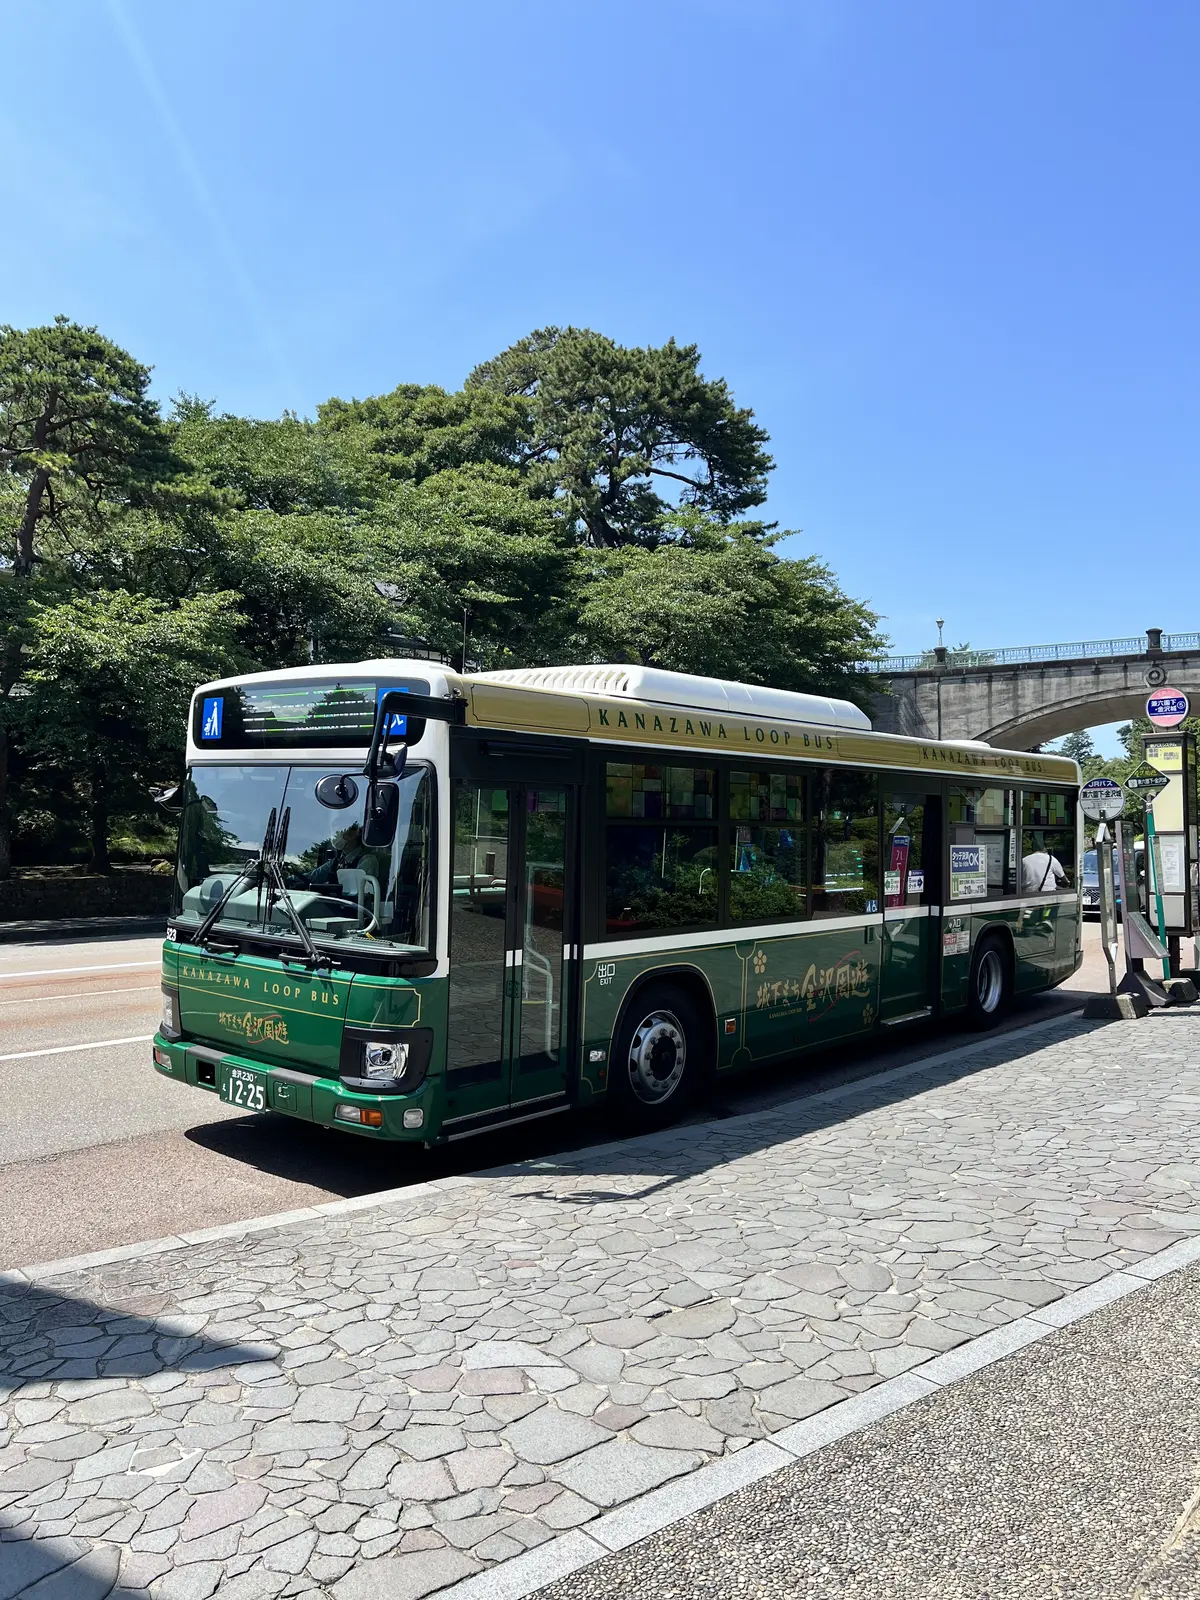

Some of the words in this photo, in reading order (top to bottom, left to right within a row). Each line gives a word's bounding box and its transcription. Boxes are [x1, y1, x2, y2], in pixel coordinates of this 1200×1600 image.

[598, 708, 727, 739] KANAZAWA
[744, 726, 791, 746] LOOP
[804, 733, 833, 750] BUS
[922, 747, 987, 767] KANAZAWA
[1088, 780, 1113, 788] JRバス
[969, 852, 979, 867] OK
[598, 963, 616, 978] 出口
[182, 966, 250, 989] KANAZAWA
[263, 982, 301, 998] LOOP
[311, 990, 340, 1005] BUS
[600, 977, 613, 986] EXIT
